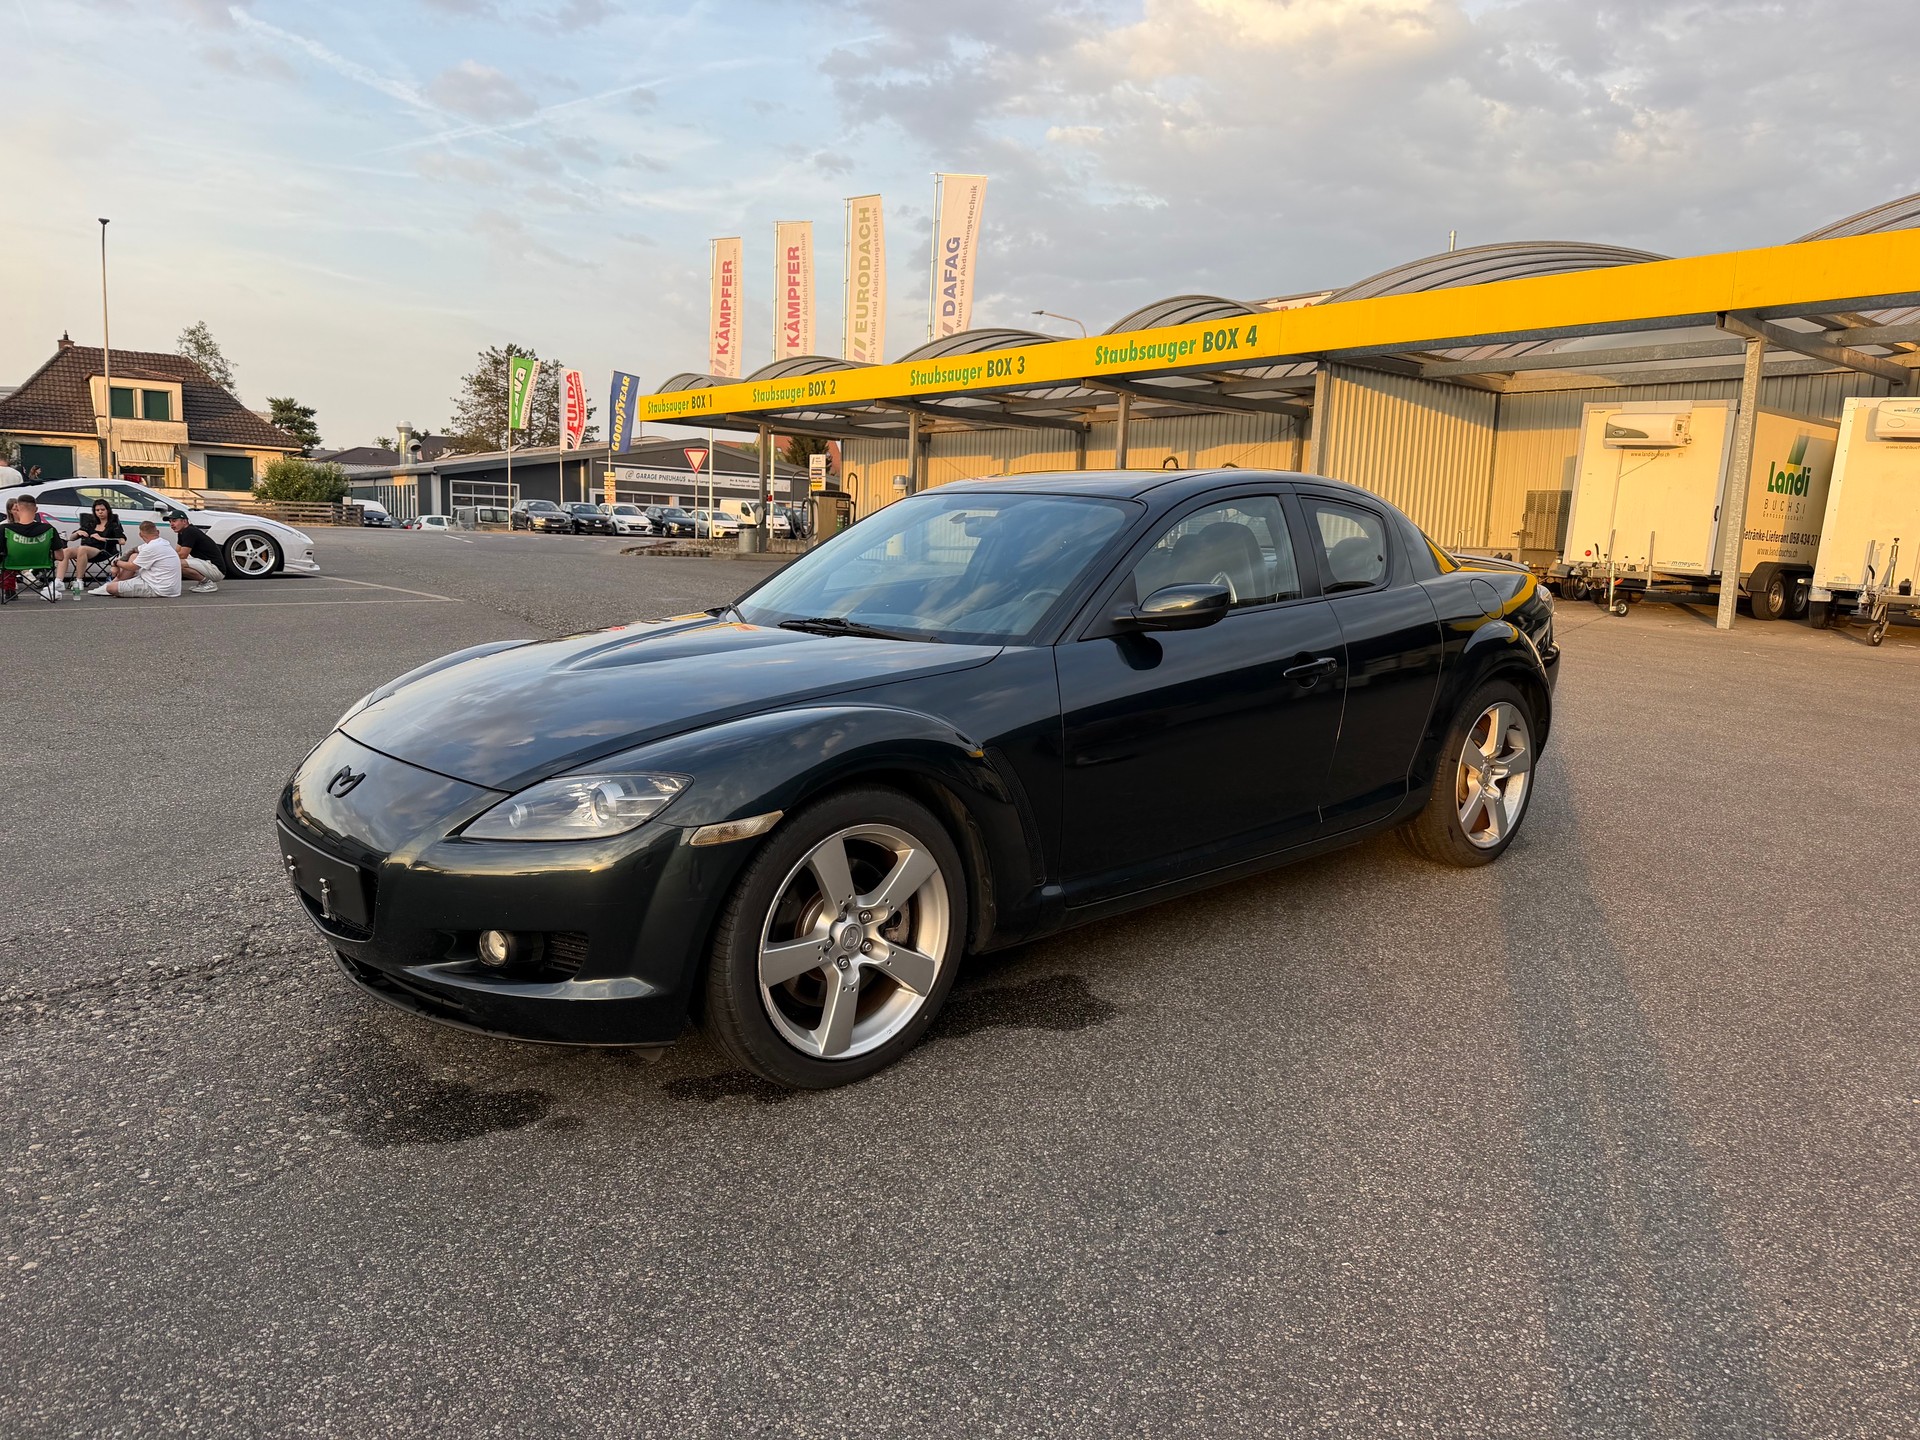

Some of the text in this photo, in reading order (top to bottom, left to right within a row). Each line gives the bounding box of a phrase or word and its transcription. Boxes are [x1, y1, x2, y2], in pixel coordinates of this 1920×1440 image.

[854, 206, 871, 334] EURODACH
[943, 237, 961, 317] DAFAG
[715, 260, 733, 355] KÄMPFER
[783, 246, 801, 348] KÄMPFER
[1095, 325, 1258, 366] Staubsauger BOX 4
[753, 379, 836, 403] Staubsauger BOX 2
[910, 355, 1025, 387] Staubsauger BOX 3
[566, 372, 577, 434] FULDA
[611, 375, 631, 451] GOODYEAR
[647, 393, 713, 415] Staubsauger BOX 1
[636, 472, 658, 481] GARAGE
[1767, 461, 1811, 497] Landi
[1764, 498, 1806, 514] BUCHSI
